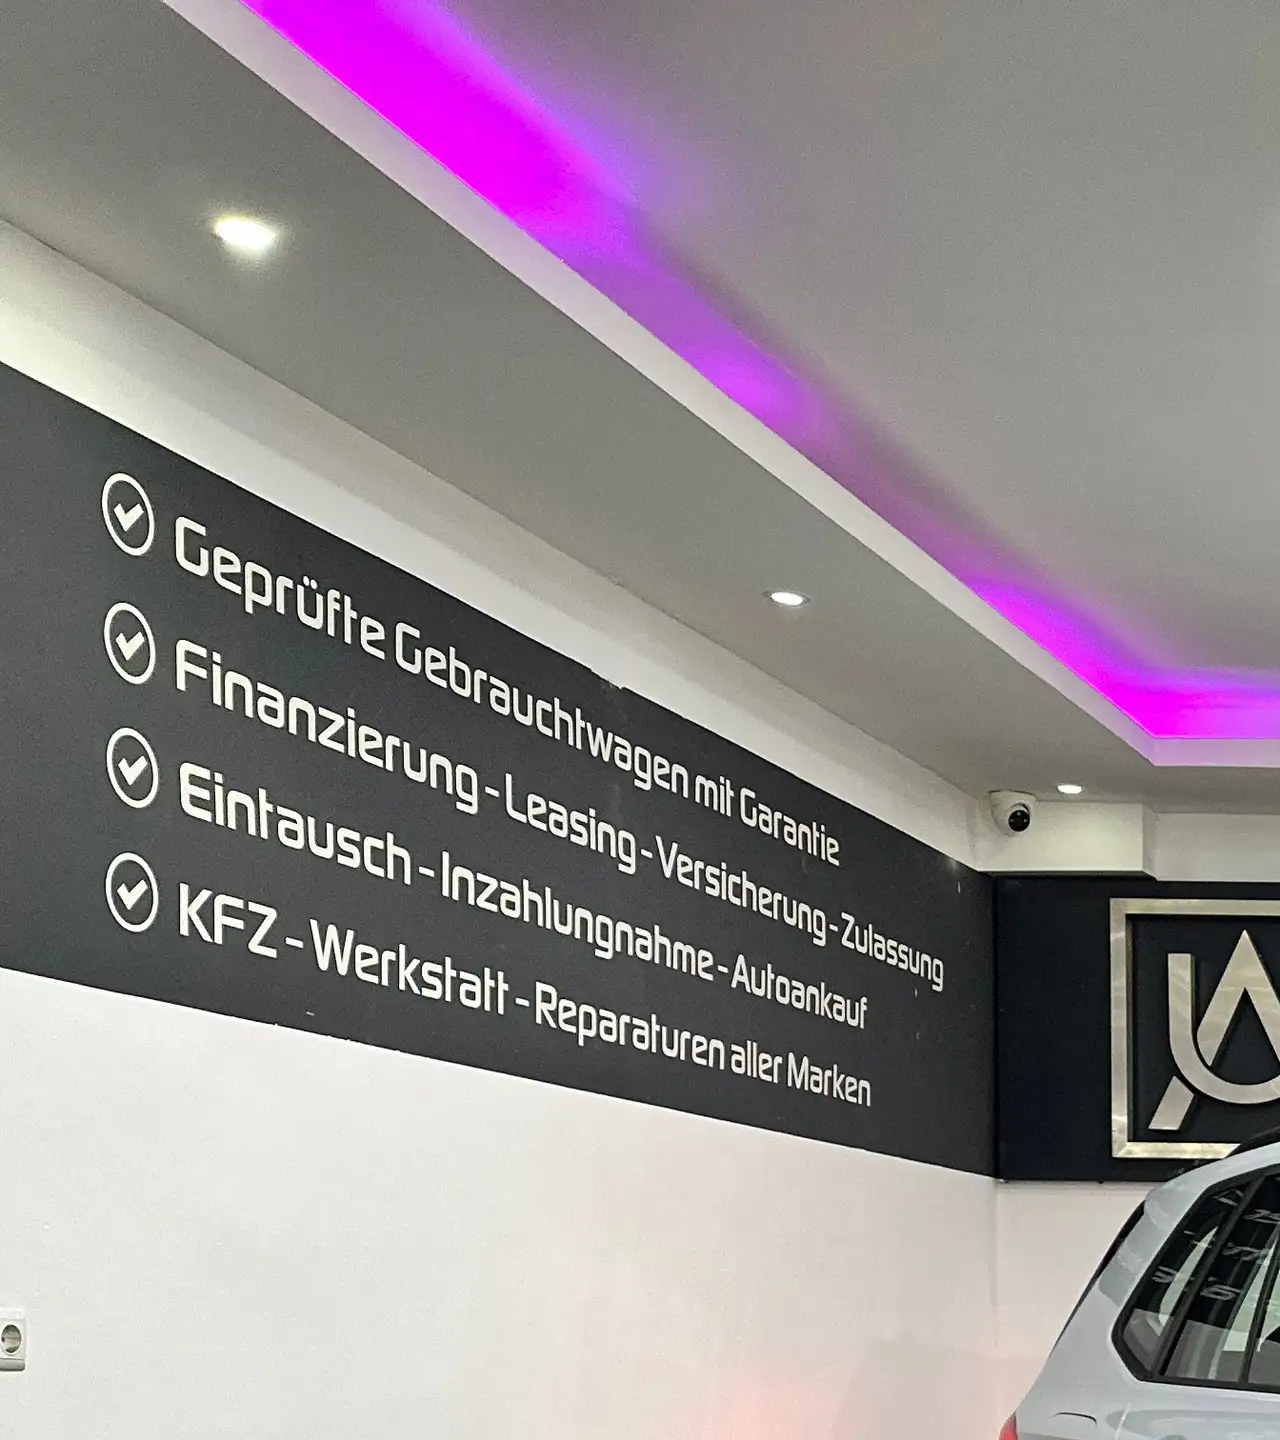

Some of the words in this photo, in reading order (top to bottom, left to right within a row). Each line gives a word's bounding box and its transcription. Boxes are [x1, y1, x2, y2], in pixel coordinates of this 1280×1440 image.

[176, 517, 385, 659] Geprüfte
[396, 623, 688, 798] Gebrauchtwagen
[695, 775, 734, 816] mit
[741, 788, 839, 866] Garantie
[176, 640, 478, 814] Finanzierung
[506, 773, 635, 874] Leasing
[656, 835, 826, 946] Versicherung
[842, 913, 943, 991] Zulassung
[180, 763, 411, 885] Eintausch
[442, 851, 713, 981] Inzahlungnahme
[731, 954, 867, 1028] Autoankauf
[180, 883, 277, 958] KFZ
[310, 919, 509, 1014] Werkstatt
[536, 982, 724, 1069] Reparaturen
[731, 1040, 782, 1083] aller
[788, 1052, 870, 1106] Marken
